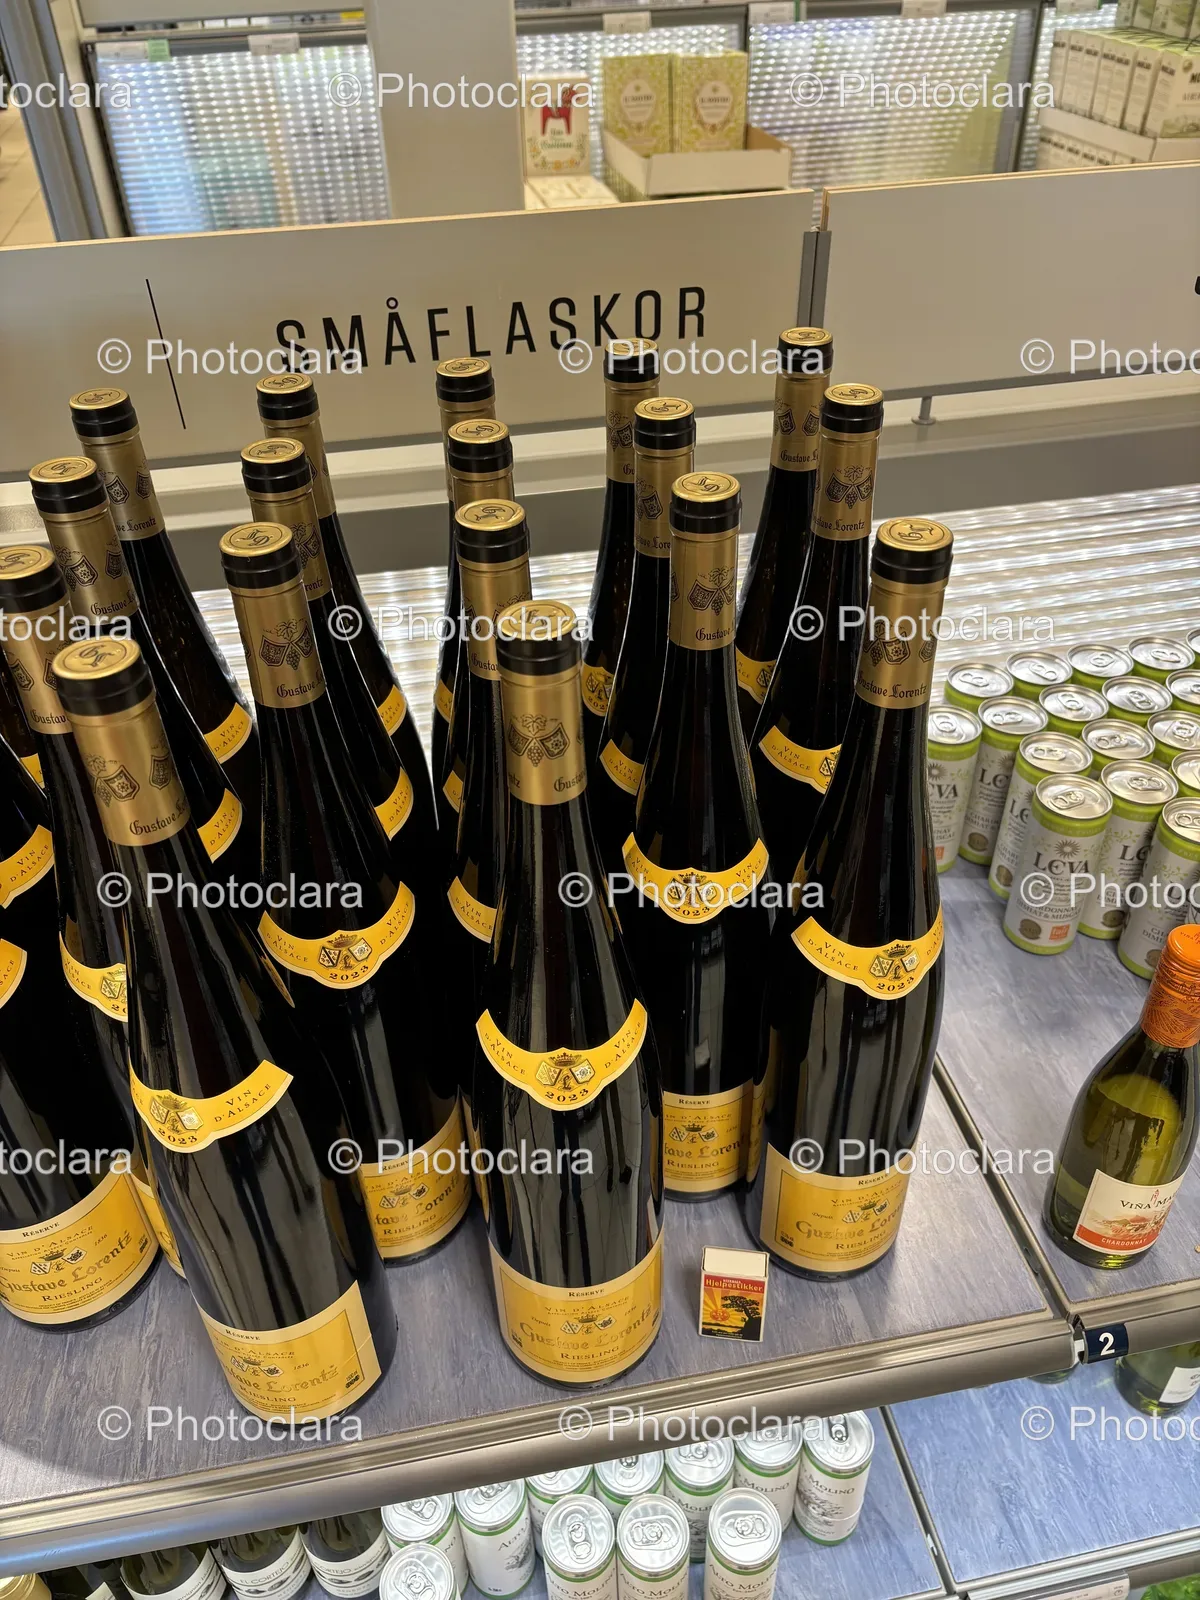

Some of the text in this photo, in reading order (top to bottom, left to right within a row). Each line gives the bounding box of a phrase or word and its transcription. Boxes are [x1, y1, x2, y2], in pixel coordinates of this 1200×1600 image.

[276, 286, 706, 373] SMÅFLASKOR
[651, 537, 670, 550] Lore
[304, 577, 324, 591] rentz
[471, 652, 498, 672] Gusta
[276, 681, 315, 698] Gustave
[889, 684, 927, 699] Lorentz
[588, 695, 609, 710] 202
[30, 709, 69, 725] Gustav
[220, 723, 235, 738] VIN
[783, 746, 800, 760] VIN
[608, 758, 638, 784] D'ALSAC
[129, 812, 176, 836] Gustave
[16, 849, 36, 867] VIN
[387, 908, 401, 926] VIN
[465, 901, 482, 917] VIN
[276, 935, 295, 950] VIN
[823, 941, 845, 957] VIN
[807, 938, 858, 971] D'ALSACE
[329, 965, 369, 981] 2023
[876, 976, 915, 991] 2023
[614, 1030, 632, 1049] VIN
[495, 1038, 513, 1059] VIN
[214, 1084, 272, 1123] D'ALSACE
[226, 1089, 252, 1106] VIN
[545, 1088, 589, 1102] 2023
[157, 1127, 198, 1145] 2023
[664, 1142, 693, 1159] tave
[1120, 1200, 1151, 1210] VIÑA
[42, 1277, 103, 1302] RIESLING
[560, 1345, 619, 1360] RIESLING
[1099, 1332, 1116, 1356] 2
[807, 1475, 856, 1495] MOLINO
[649, 1572, 688, 1597] MOLIN
